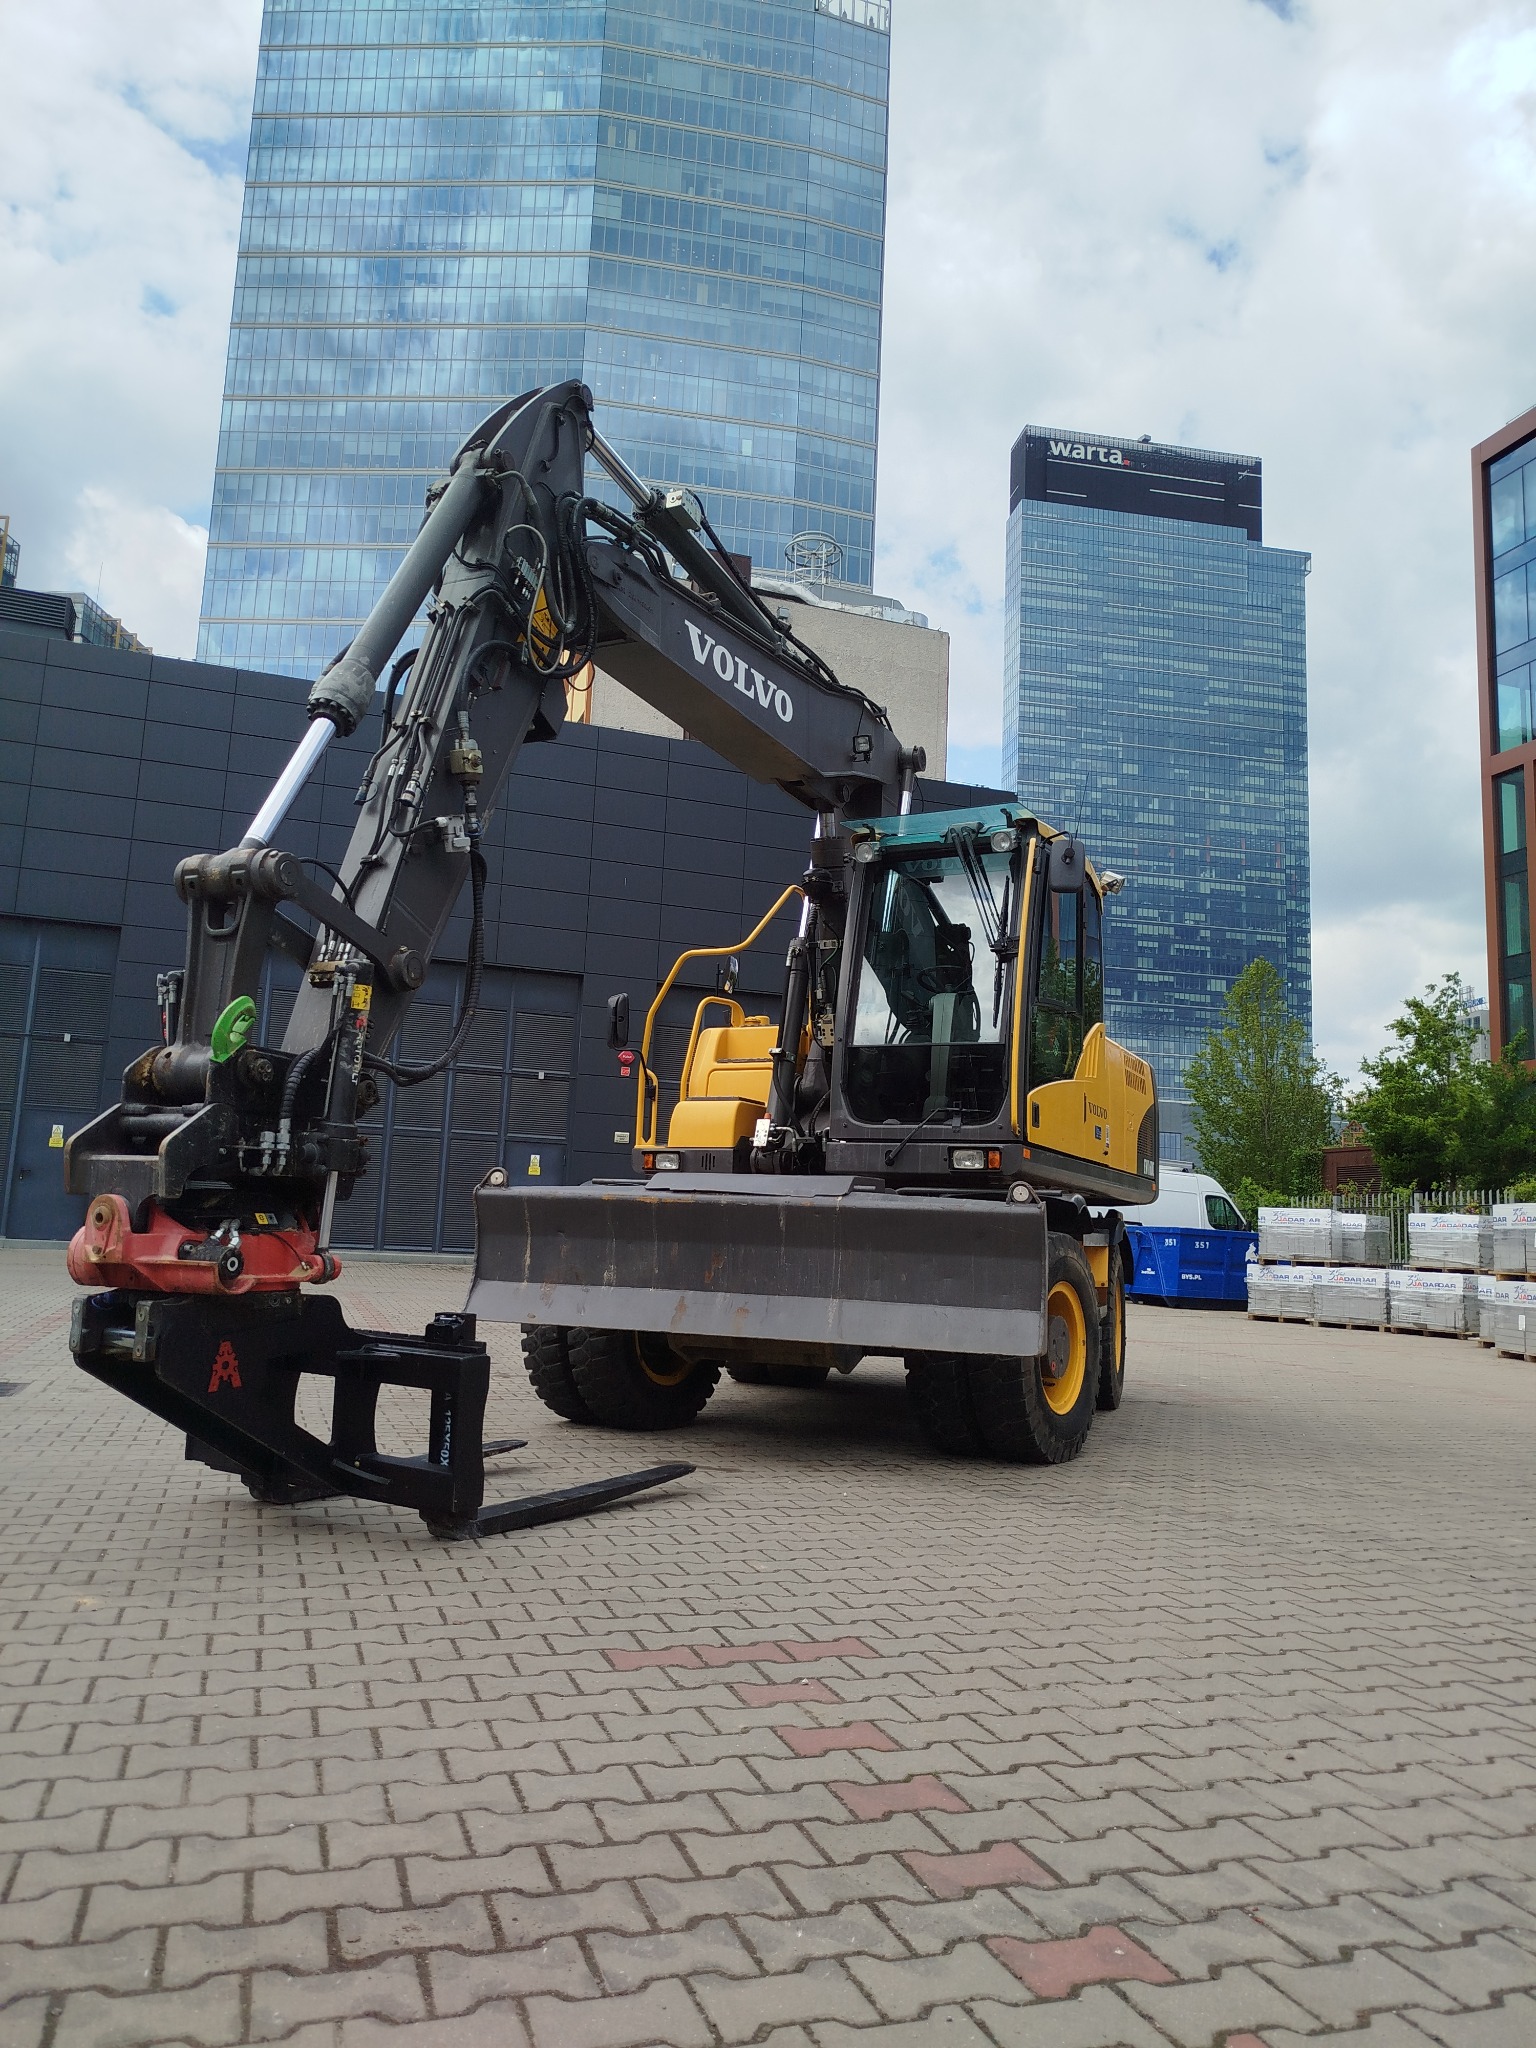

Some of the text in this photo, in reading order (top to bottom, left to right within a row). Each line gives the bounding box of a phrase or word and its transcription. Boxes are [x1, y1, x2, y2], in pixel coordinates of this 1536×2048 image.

[684, 619, 794, 722] VOLVO
[1088, 1102, 1108, 1120] VOLVO
[1164, 1238, 1177, 1247] 351
[1194, 1241, 1210, 1249] 351
